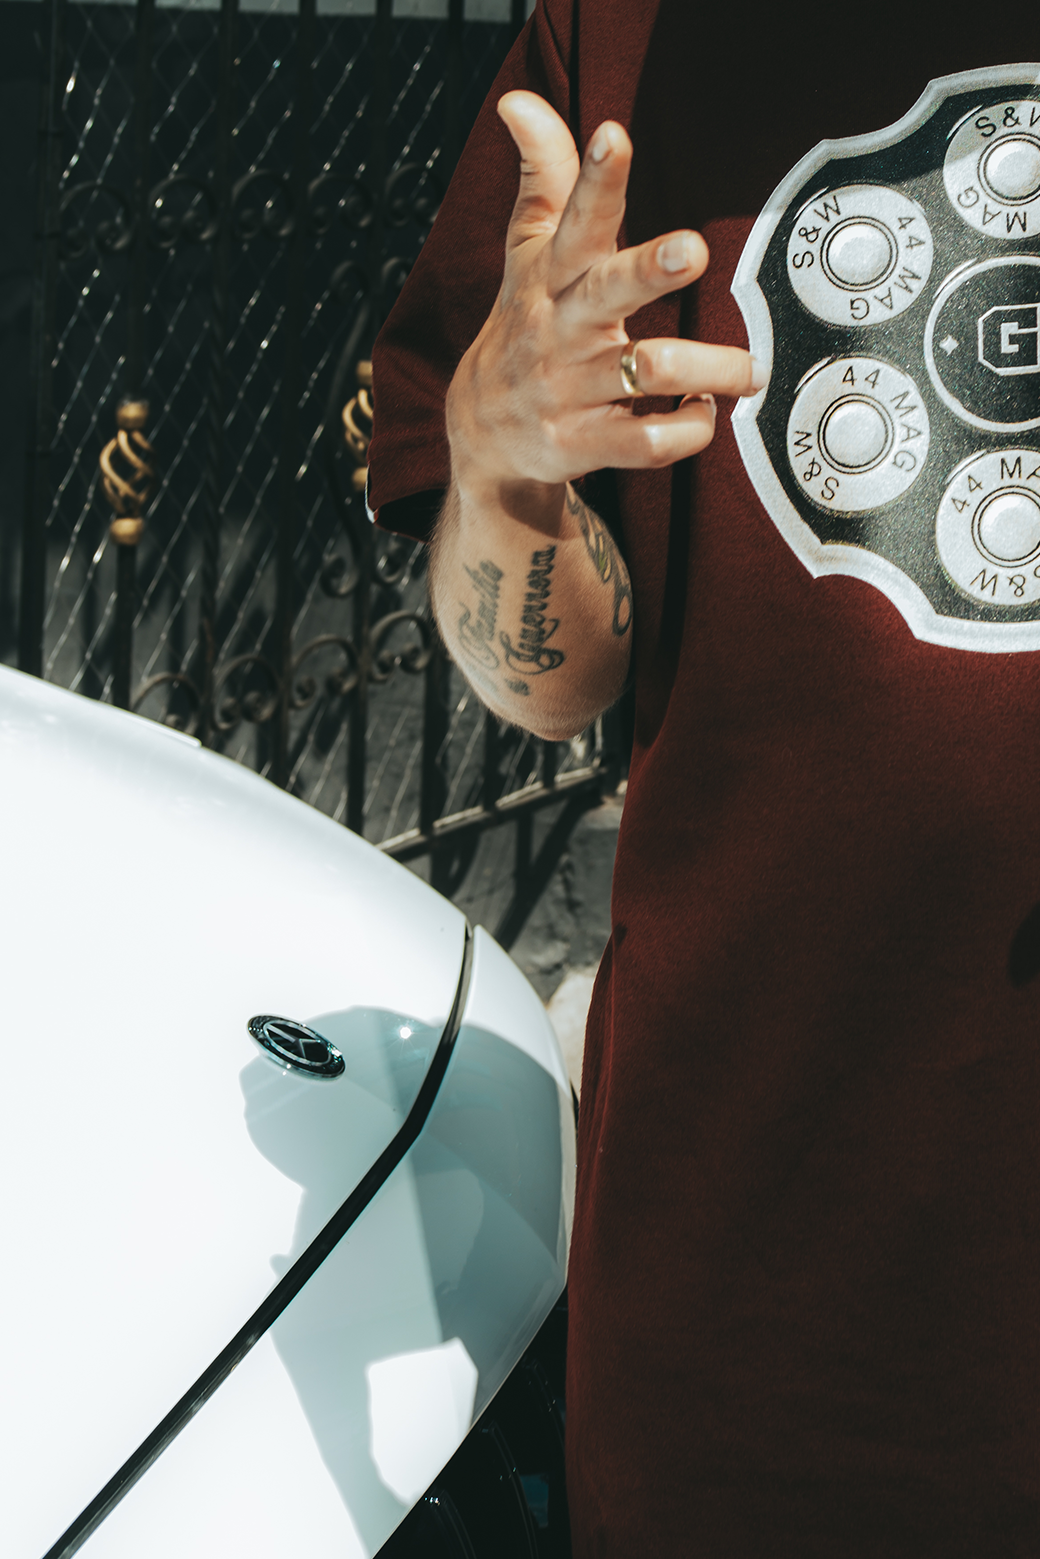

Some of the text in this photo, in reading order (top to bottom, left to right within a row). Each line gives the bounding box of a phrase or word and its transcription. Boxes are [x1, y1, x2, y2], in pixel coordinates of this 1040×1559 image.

[792, 195, 841, 269] S&W
[957, 186, 1027, 234] MAG
[850, 216, 926, 320] 44 MAG
[842, 365, 923, 472] 44 MAG
[793, 430, 839, 501] S&W
[951, 474, 983, 514] 44
